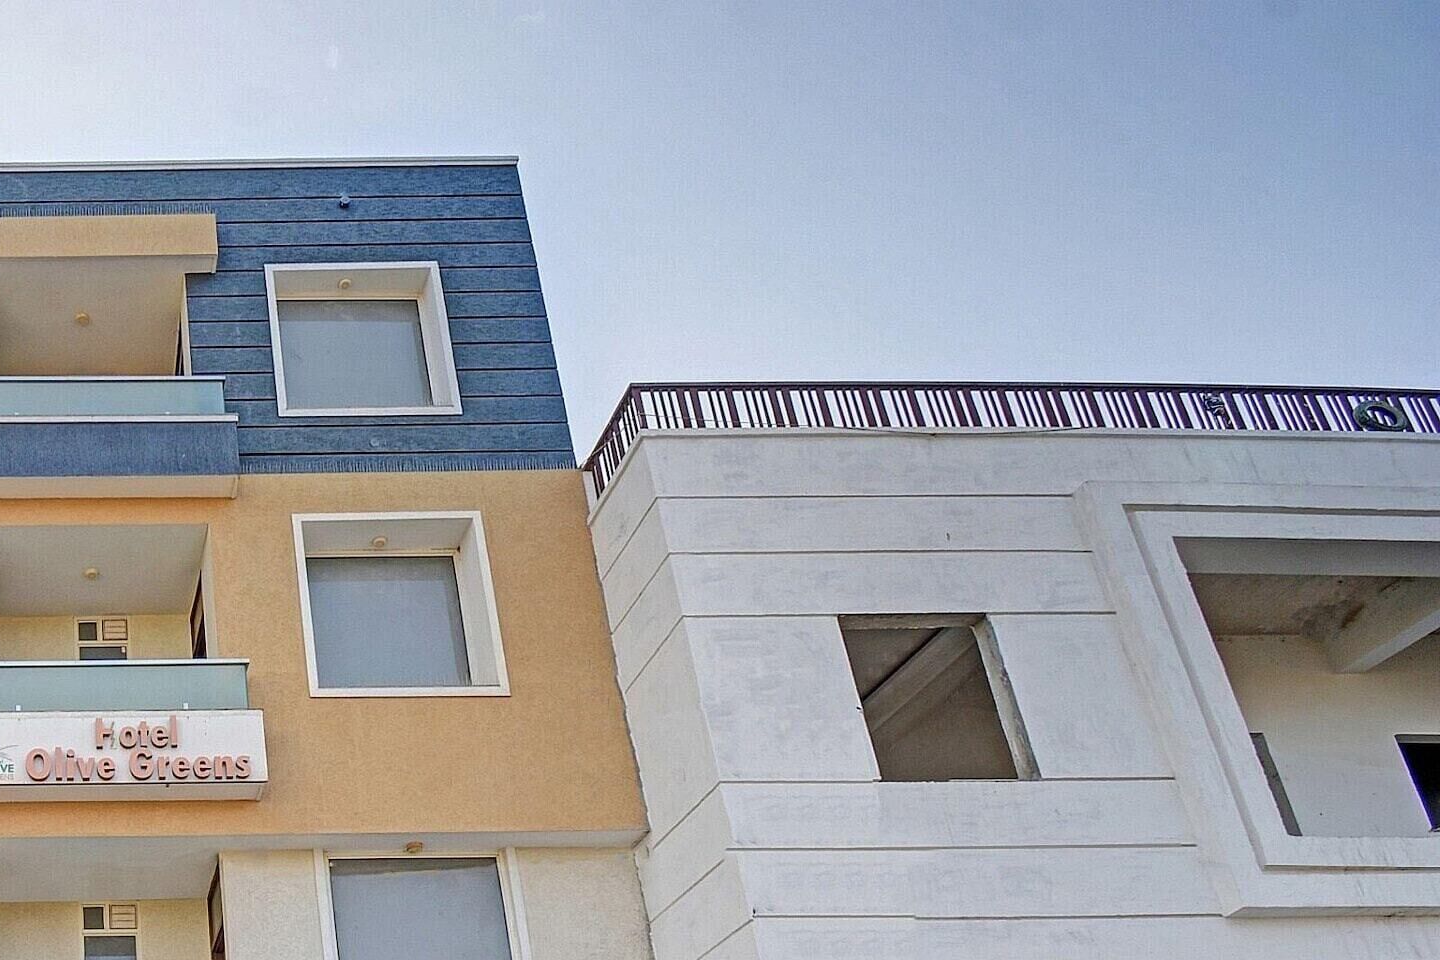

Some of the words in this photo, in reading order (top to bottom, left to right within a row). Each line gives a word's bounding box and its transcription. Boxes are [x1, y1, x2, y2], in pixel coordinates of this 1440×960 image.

[95, 715, 179, 750] Hotel
[25, 747, 116, 782] Olive
[129, 749, 252, 781] Greens
